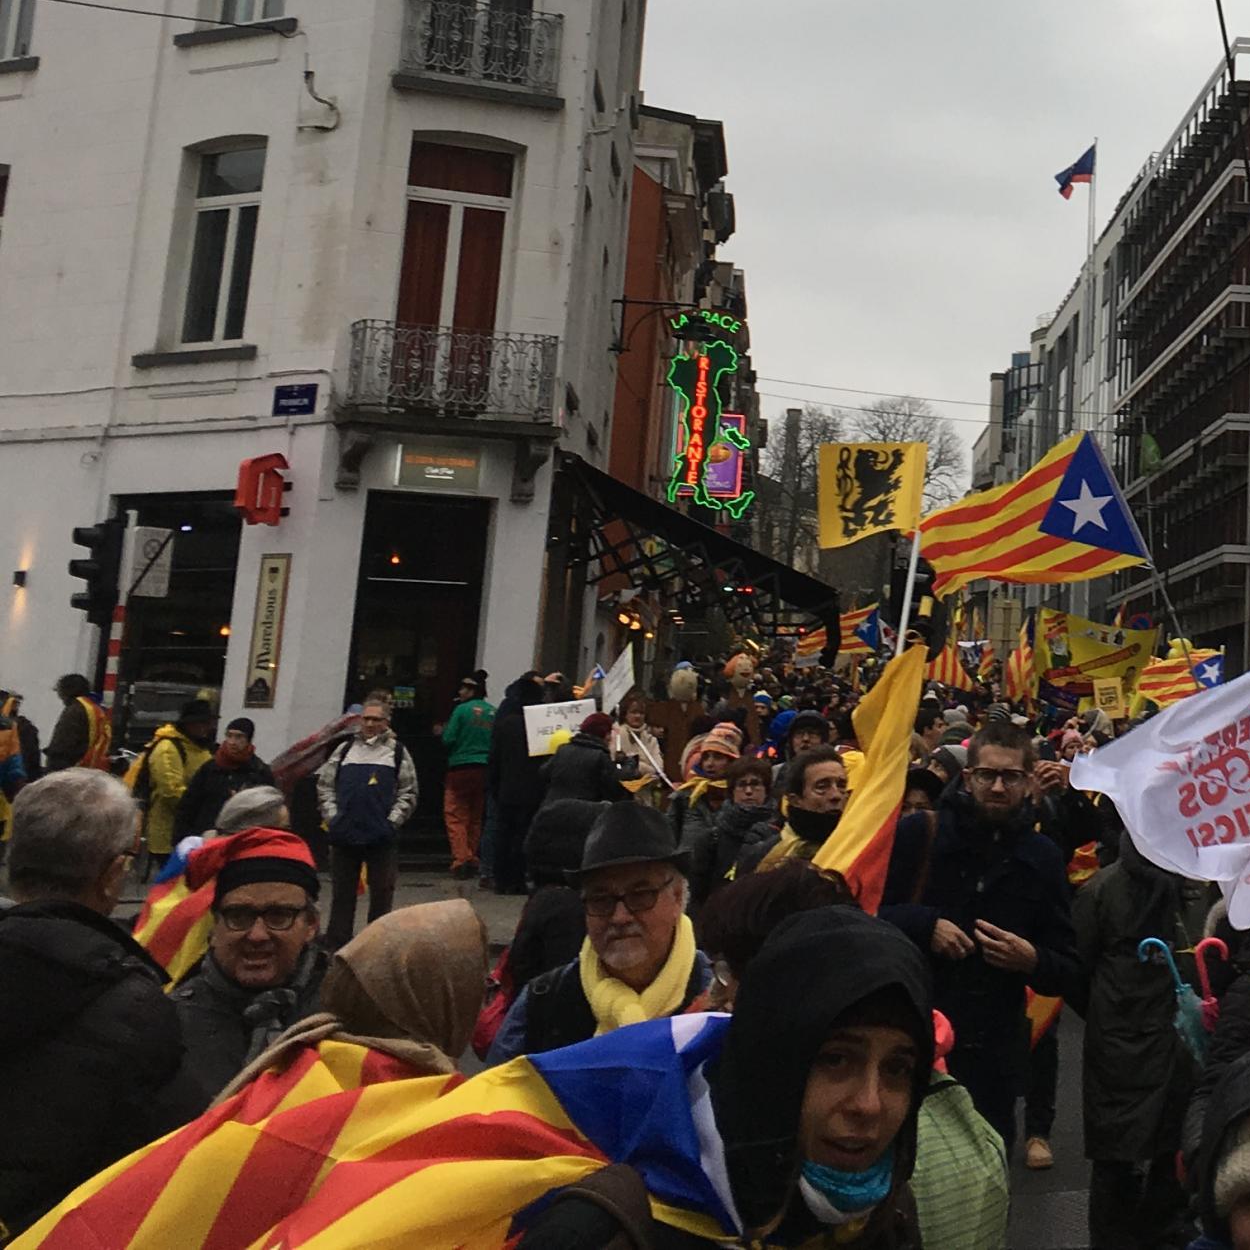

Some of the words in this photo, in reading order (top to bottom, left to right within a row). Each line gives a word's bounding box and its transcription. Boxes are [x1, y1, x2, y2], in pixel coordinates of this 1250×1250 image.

[670, 313, 689, 329] LA
[686, 356, 711, 485] RISTORANTE
[255, 588, 278, 671] Maredsous
